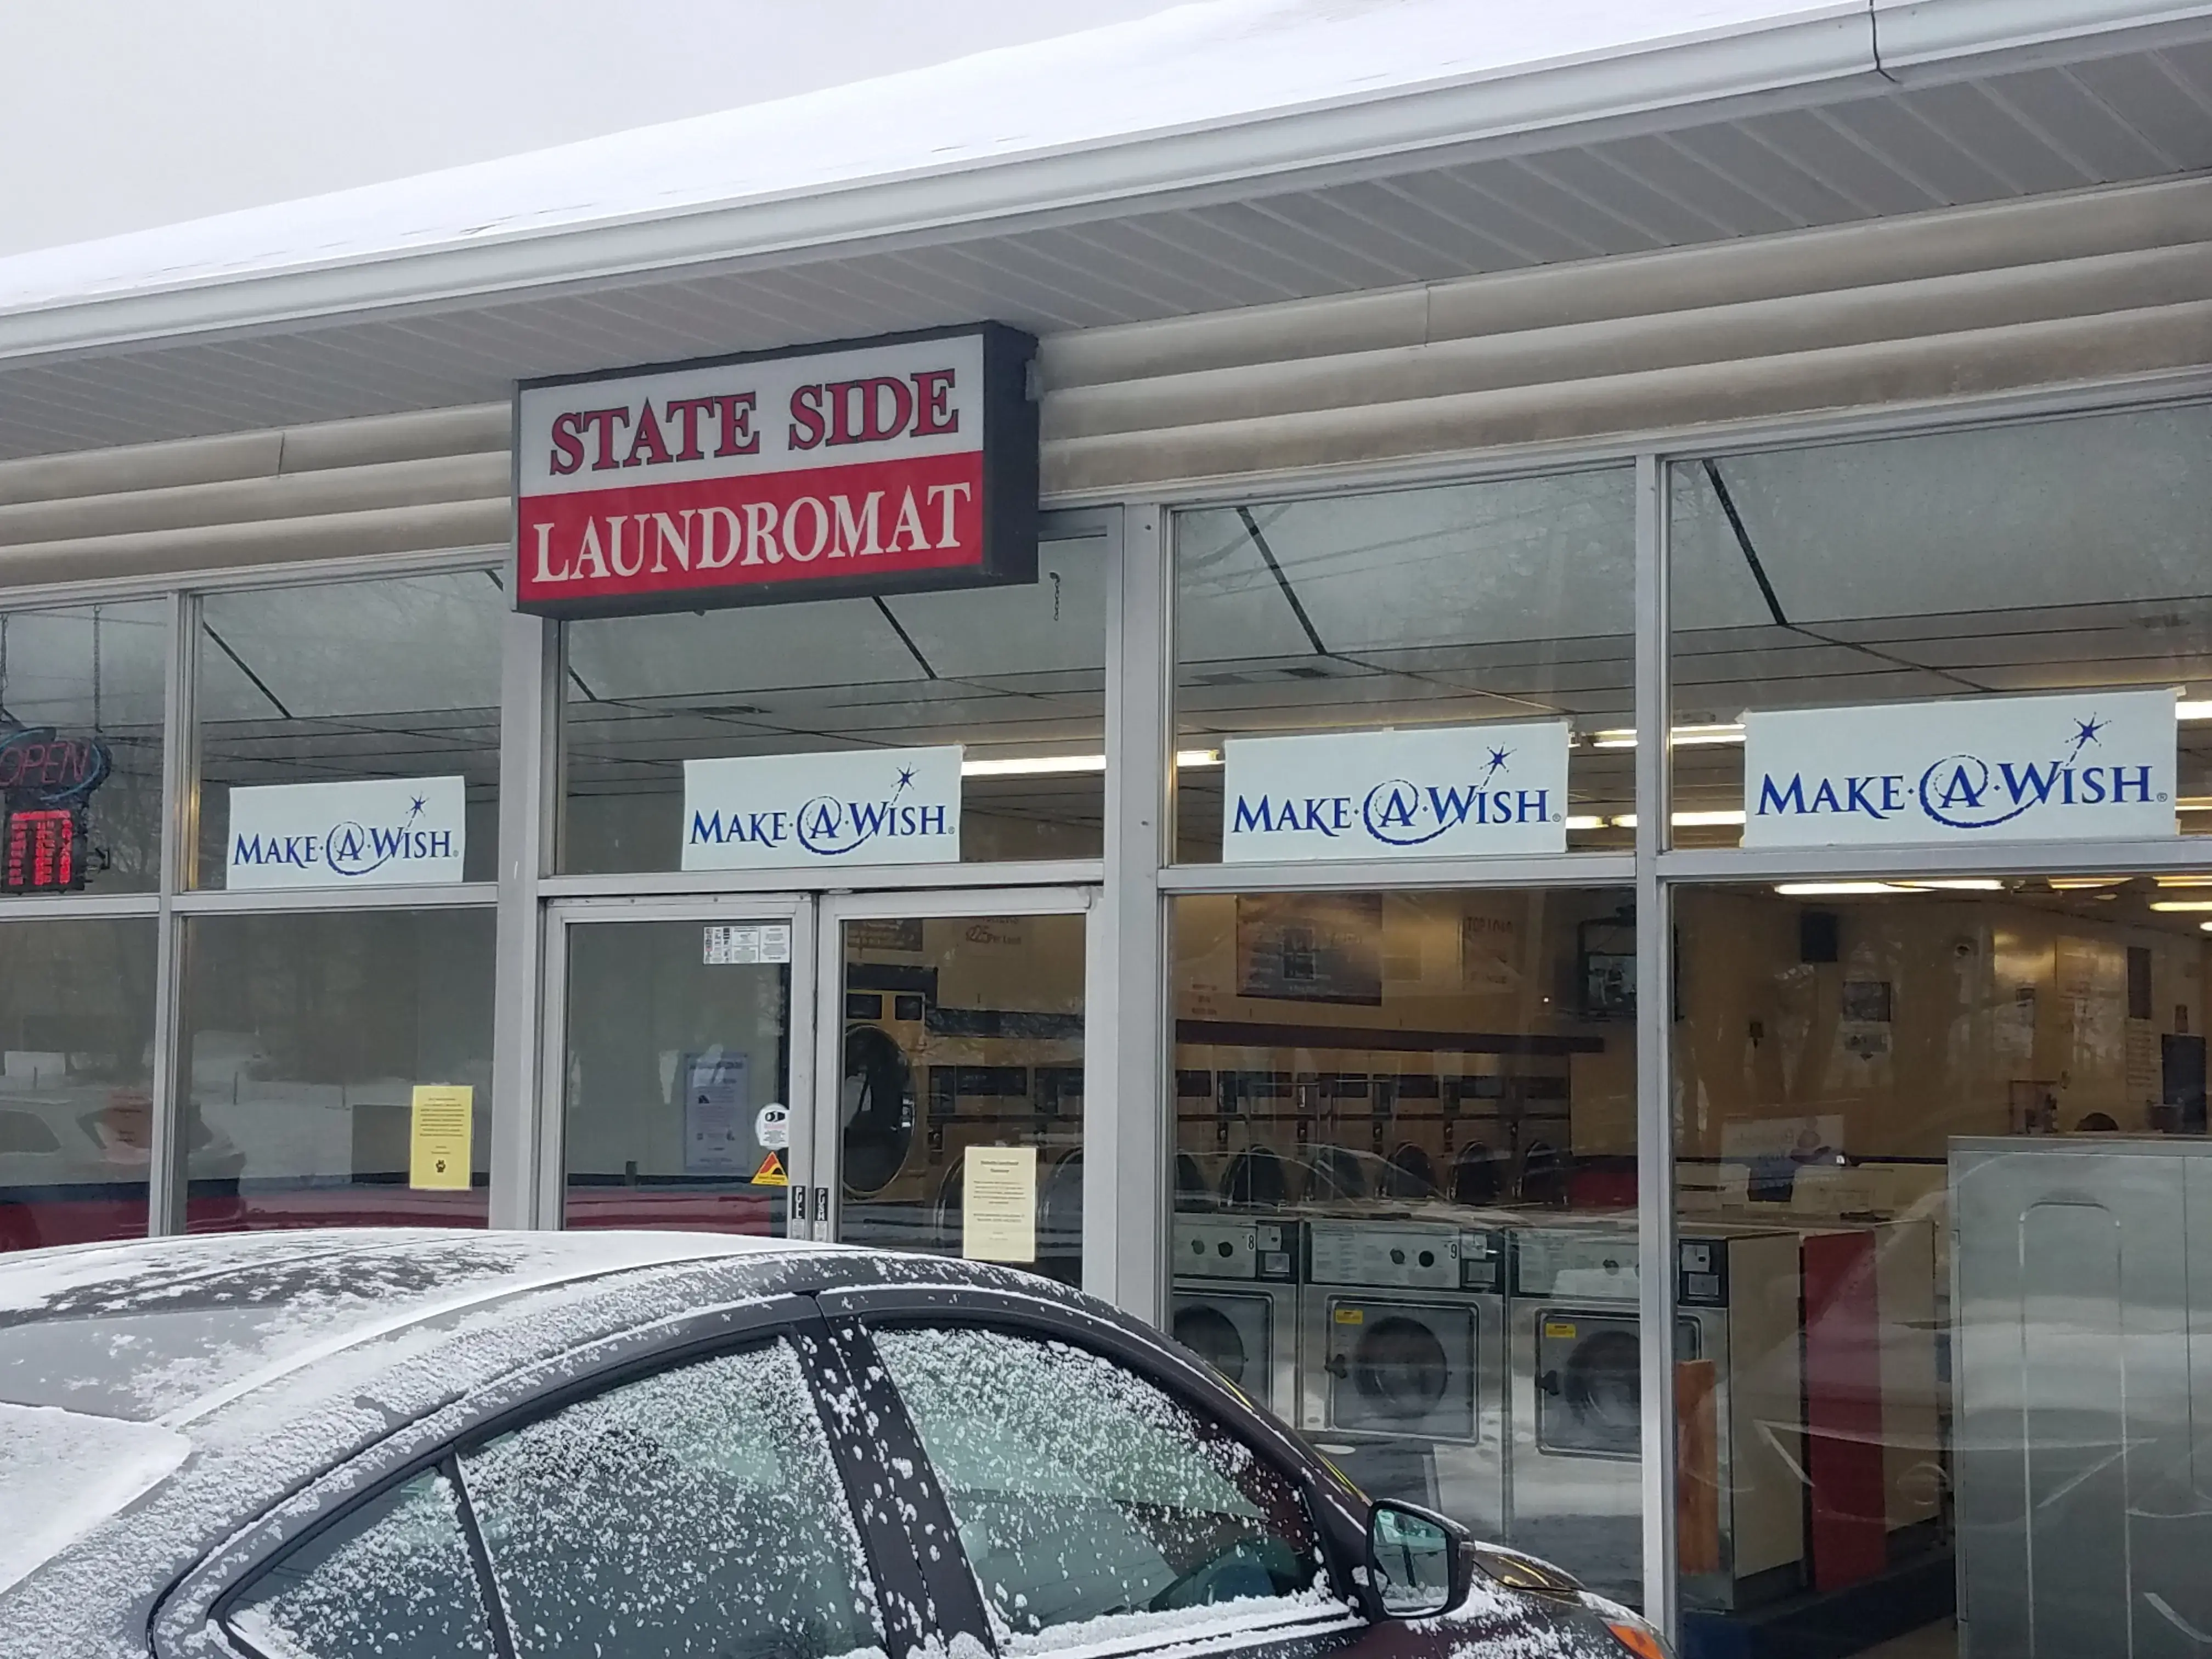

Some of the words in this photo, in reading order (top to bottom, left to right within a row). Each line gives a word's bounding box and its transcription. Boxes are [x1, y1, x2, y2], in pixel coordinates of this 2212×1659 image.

[550, 392, 760, 476] STATE
[788, 368, 959, 451] SIDE
[531, 481, 973, 584] LAUNDROMAT
[0, 740, 91, 786] OPEN
[817, 1188, 826, 1221] PUSH
[1248, 1235, 1255, 1250] 8
[1451, 1244, 1458, 1259] 9
